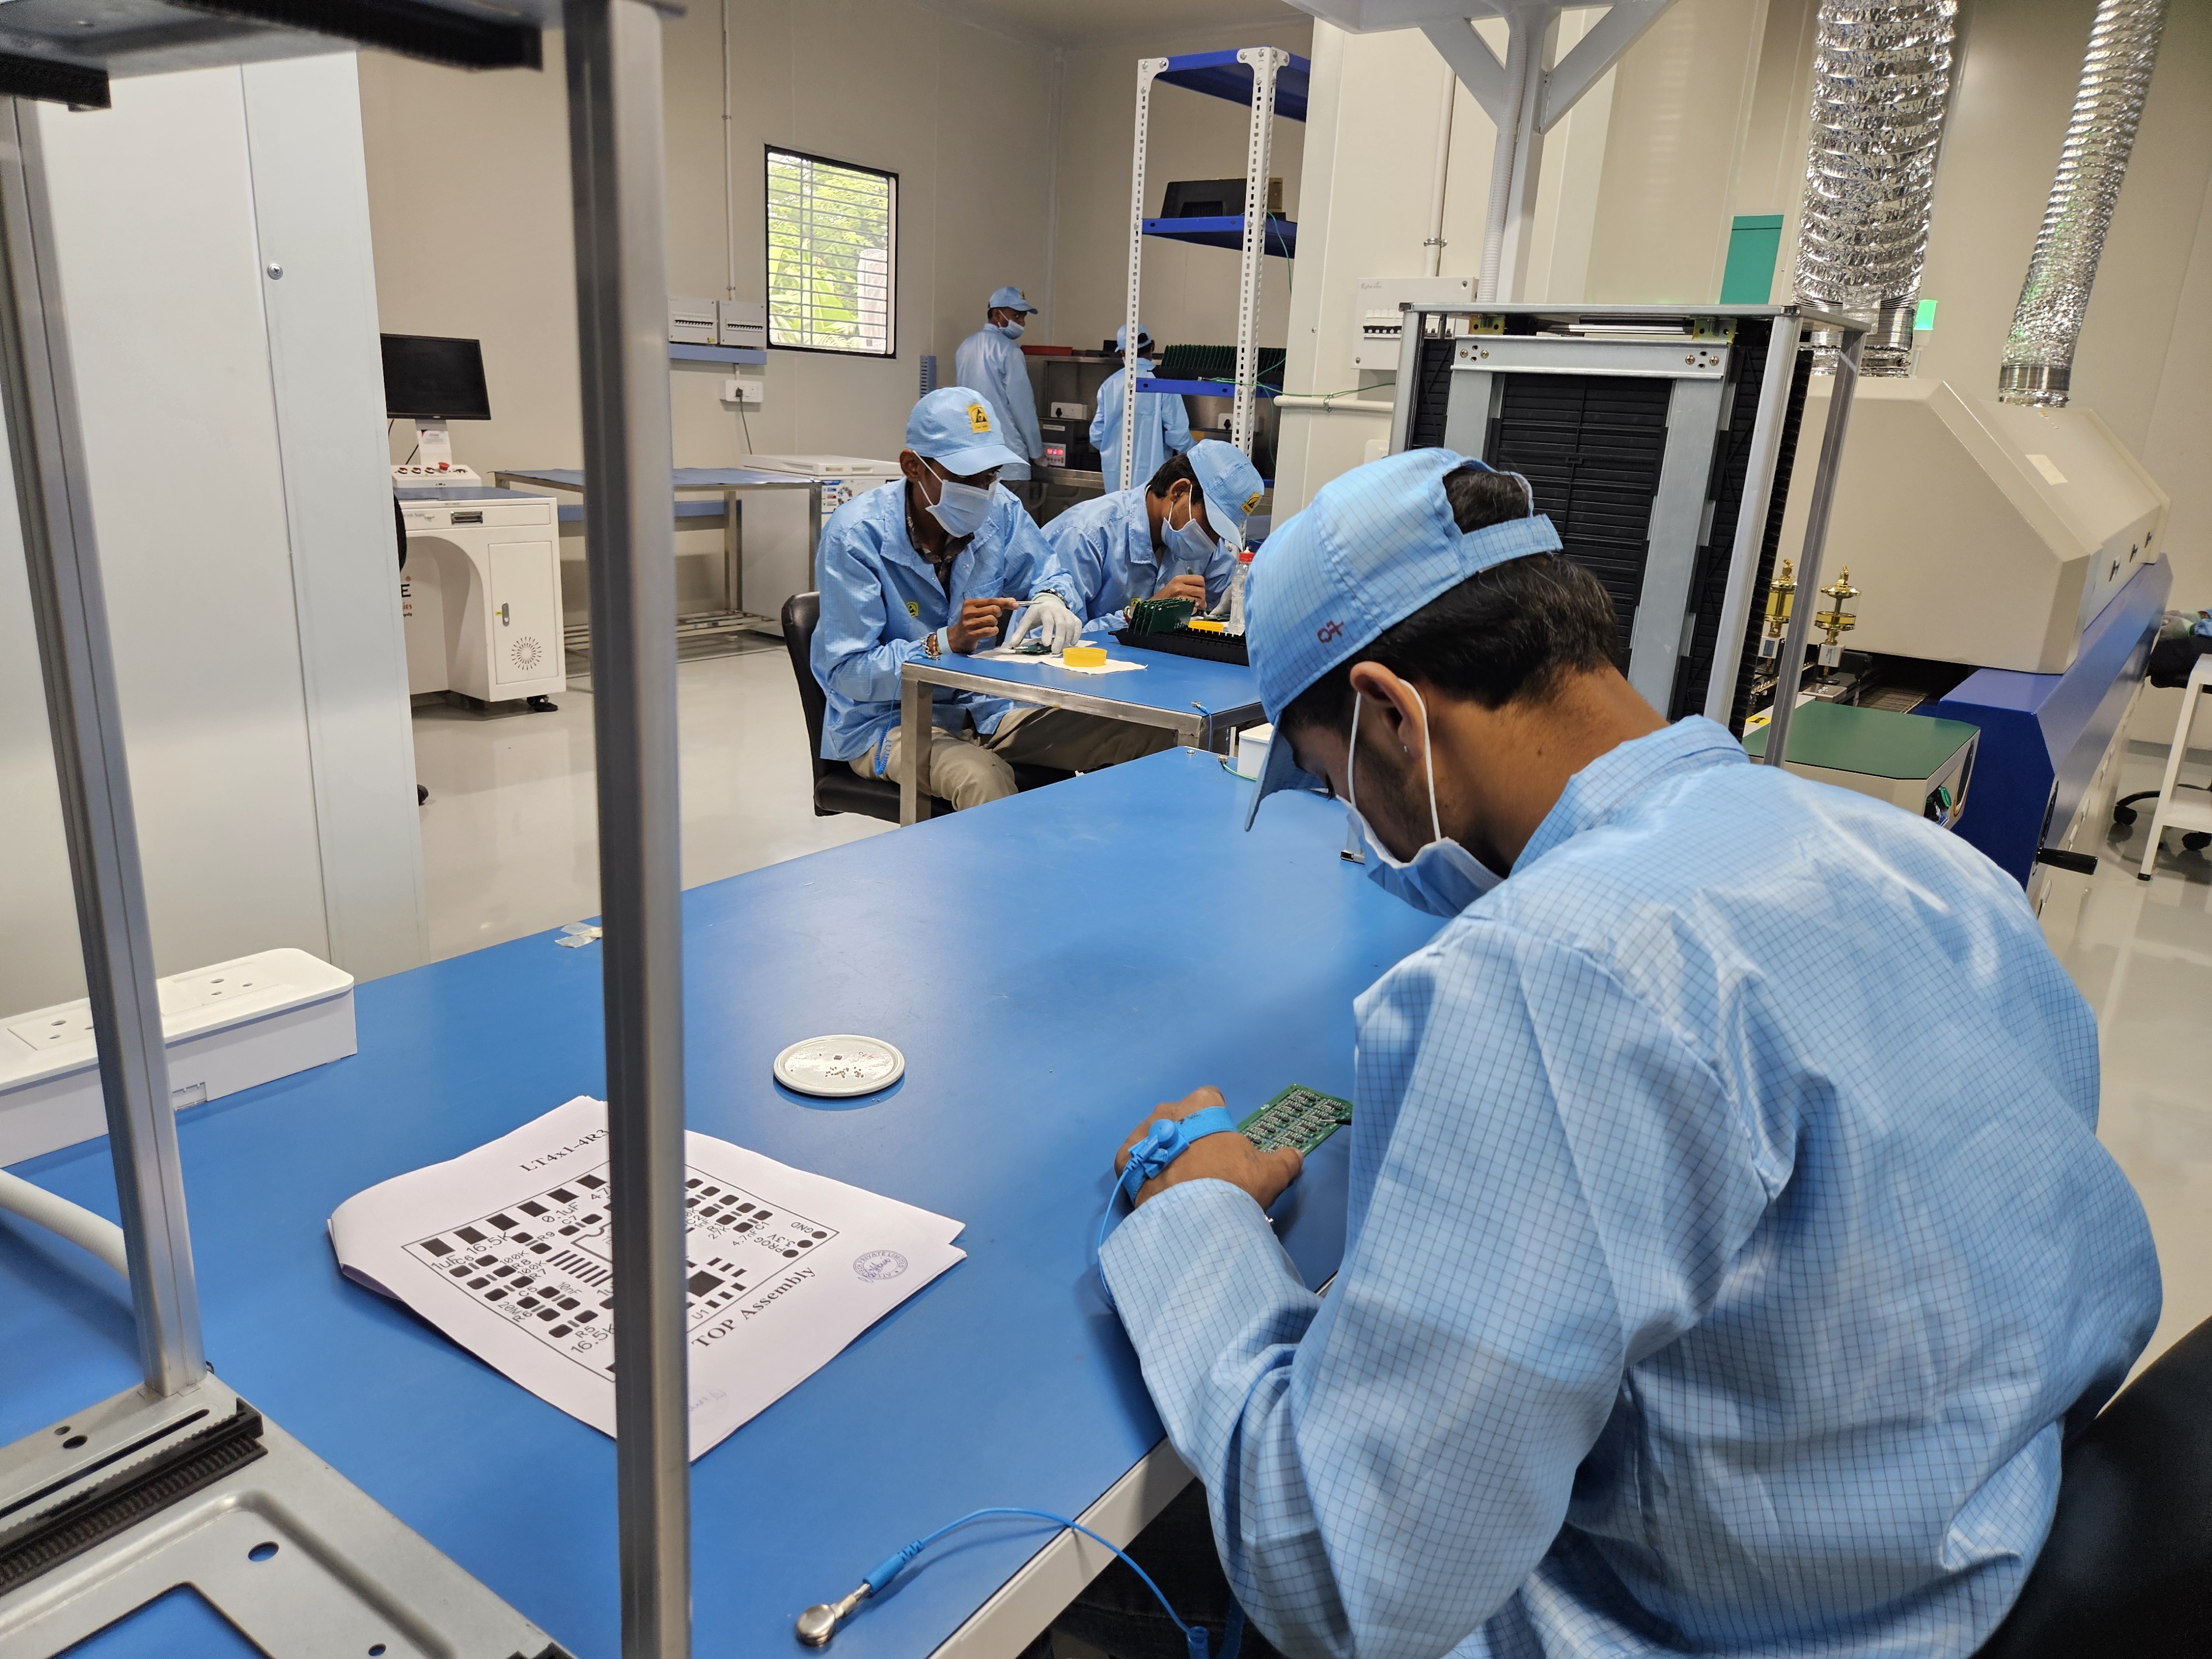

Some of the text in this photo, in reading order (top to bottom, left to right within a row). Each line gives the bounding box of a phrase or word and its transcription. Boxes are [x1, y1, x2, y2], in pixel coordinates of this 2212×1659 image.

[591, 1186, 611, 1199] 47
[542, 1201, 578, 1222] 0.1uF
[562, 1215, 577, 1224] C7
[686, 1215, 704, 1224] C2
[695, 1218, 709, 1228] 1nF
[755, 1221, 770, 1230] C1
[707, 1223, 722, 1233] R1
[708, 1226, 731, 1239] 27K
[790, 1222, 813, 1233] GND
[537, 1232, 555, 1241] R9
[732, 1229, 758, 1246] 4.7nF
[767, 1234, 796, 1247] 3.3V
[466, 1232, 512, 1254] 16.5K
[754, 1237, 786, 1253] PROG
[431, 1255, 457, 1270] 1uF
[456, 1255, 474, 1265] C6
[499, 1250, 529, 1264] 100K
[512, 1259, 531, 1269] R8
[517, 1260, 547, 1276] 100K
[529, 1268, 546, 1280] R7
[519, 1286, 538, 1297] C5
[557, 1281, 582, 1295] 10nF
[498, 1301, 520, 1315] 20M
[691, 1319, 737, 1347] TOP
[740, 1267, 816, 1320] Assembly
[512, 1311, 533, 1322] R6
[691, 1309, 709, 1319] U1
[571, 1323, 614, 1353] 16.5K
[575, 1326, 596, 1338] R5
